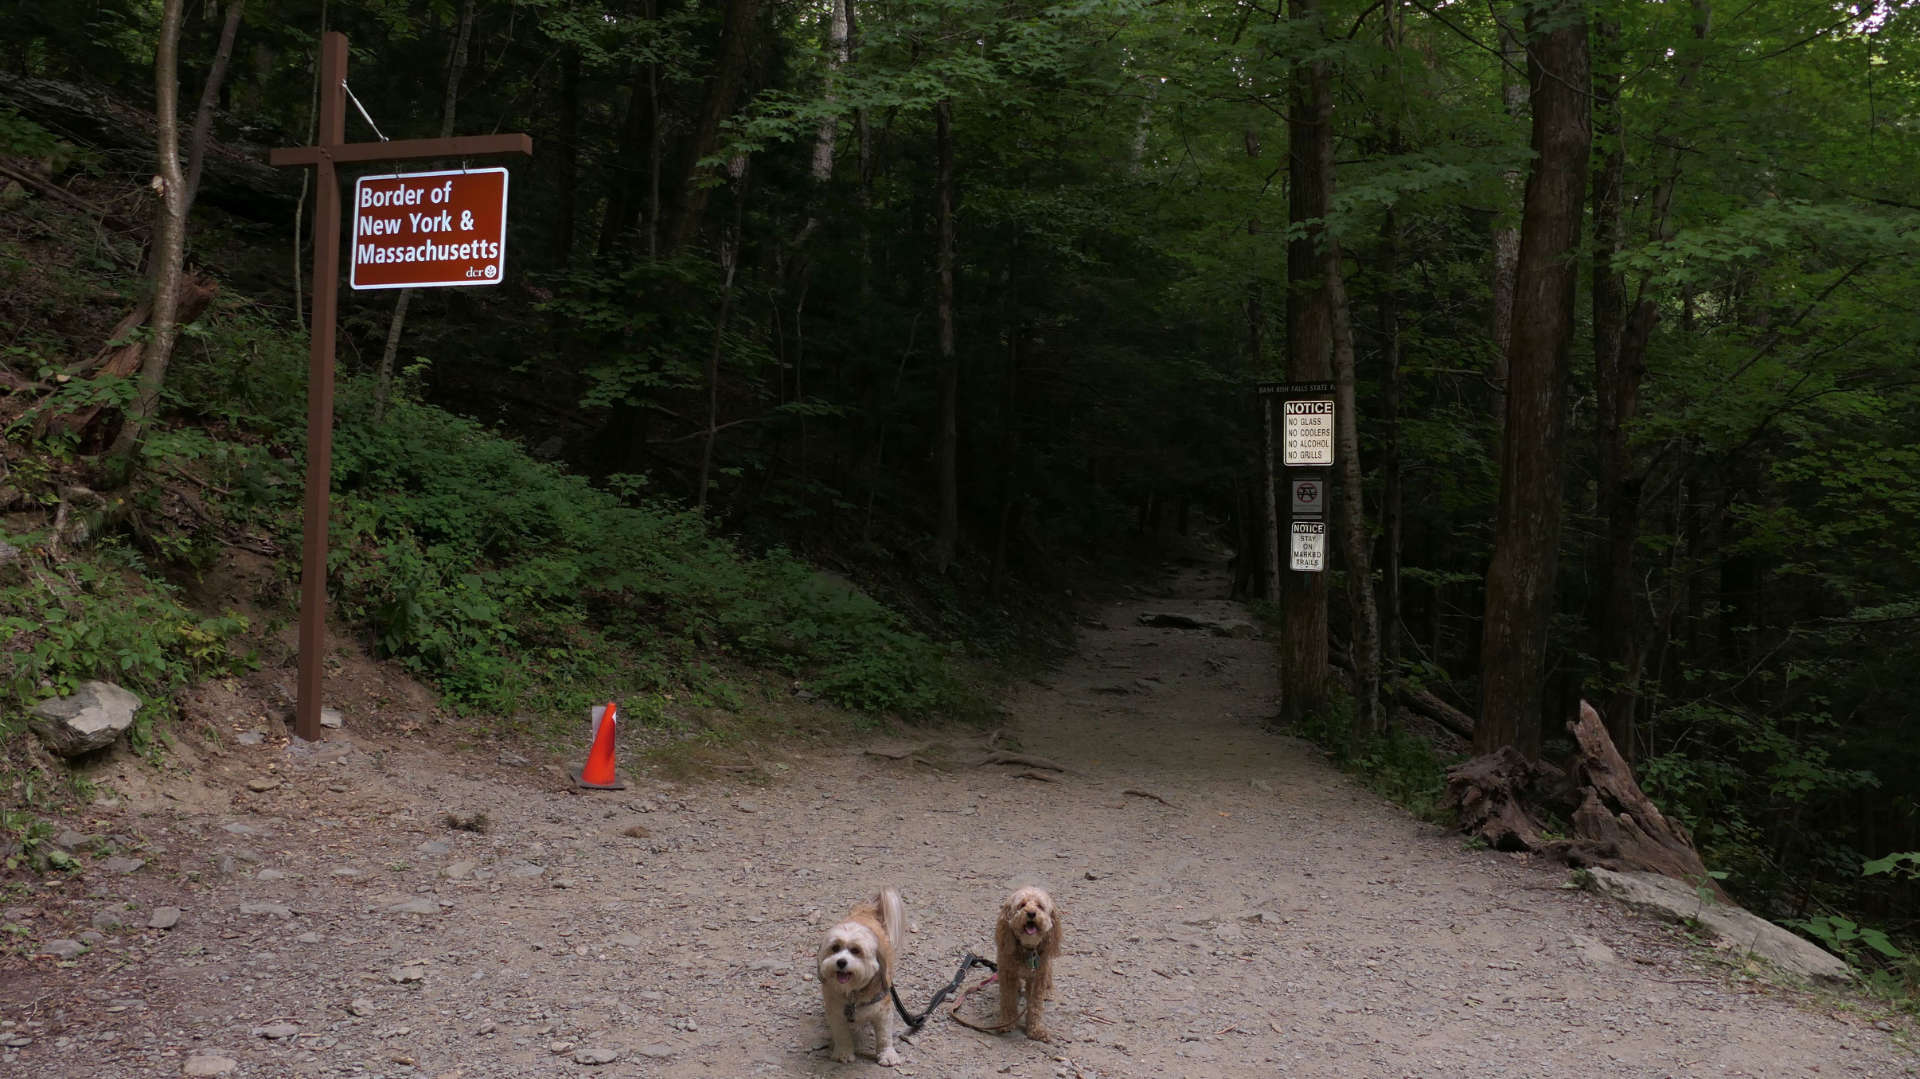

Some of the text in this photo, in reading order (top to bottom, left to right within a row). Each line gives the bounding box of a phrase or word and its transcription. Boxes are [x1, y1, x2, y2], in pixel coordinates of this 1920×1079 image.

[361, 180, 452, 208] Border of
[359, 209, 474, 236] New York &
[357, 239, 498, 264] Massachusetts
[465, 266, 484, 278] dcr
[1286, 403, 1332, 414] NOTICE
[1288, 418, 1321, 426] NO GLASS
[1288, 429, 1330, 437] NO COOLERS
[1288, 440, 1329, 448] NO ALCOHOL
[1288, 451, 1322, 459] NO GRILLS
[1293, 524, 1323, 533] NOTICE
